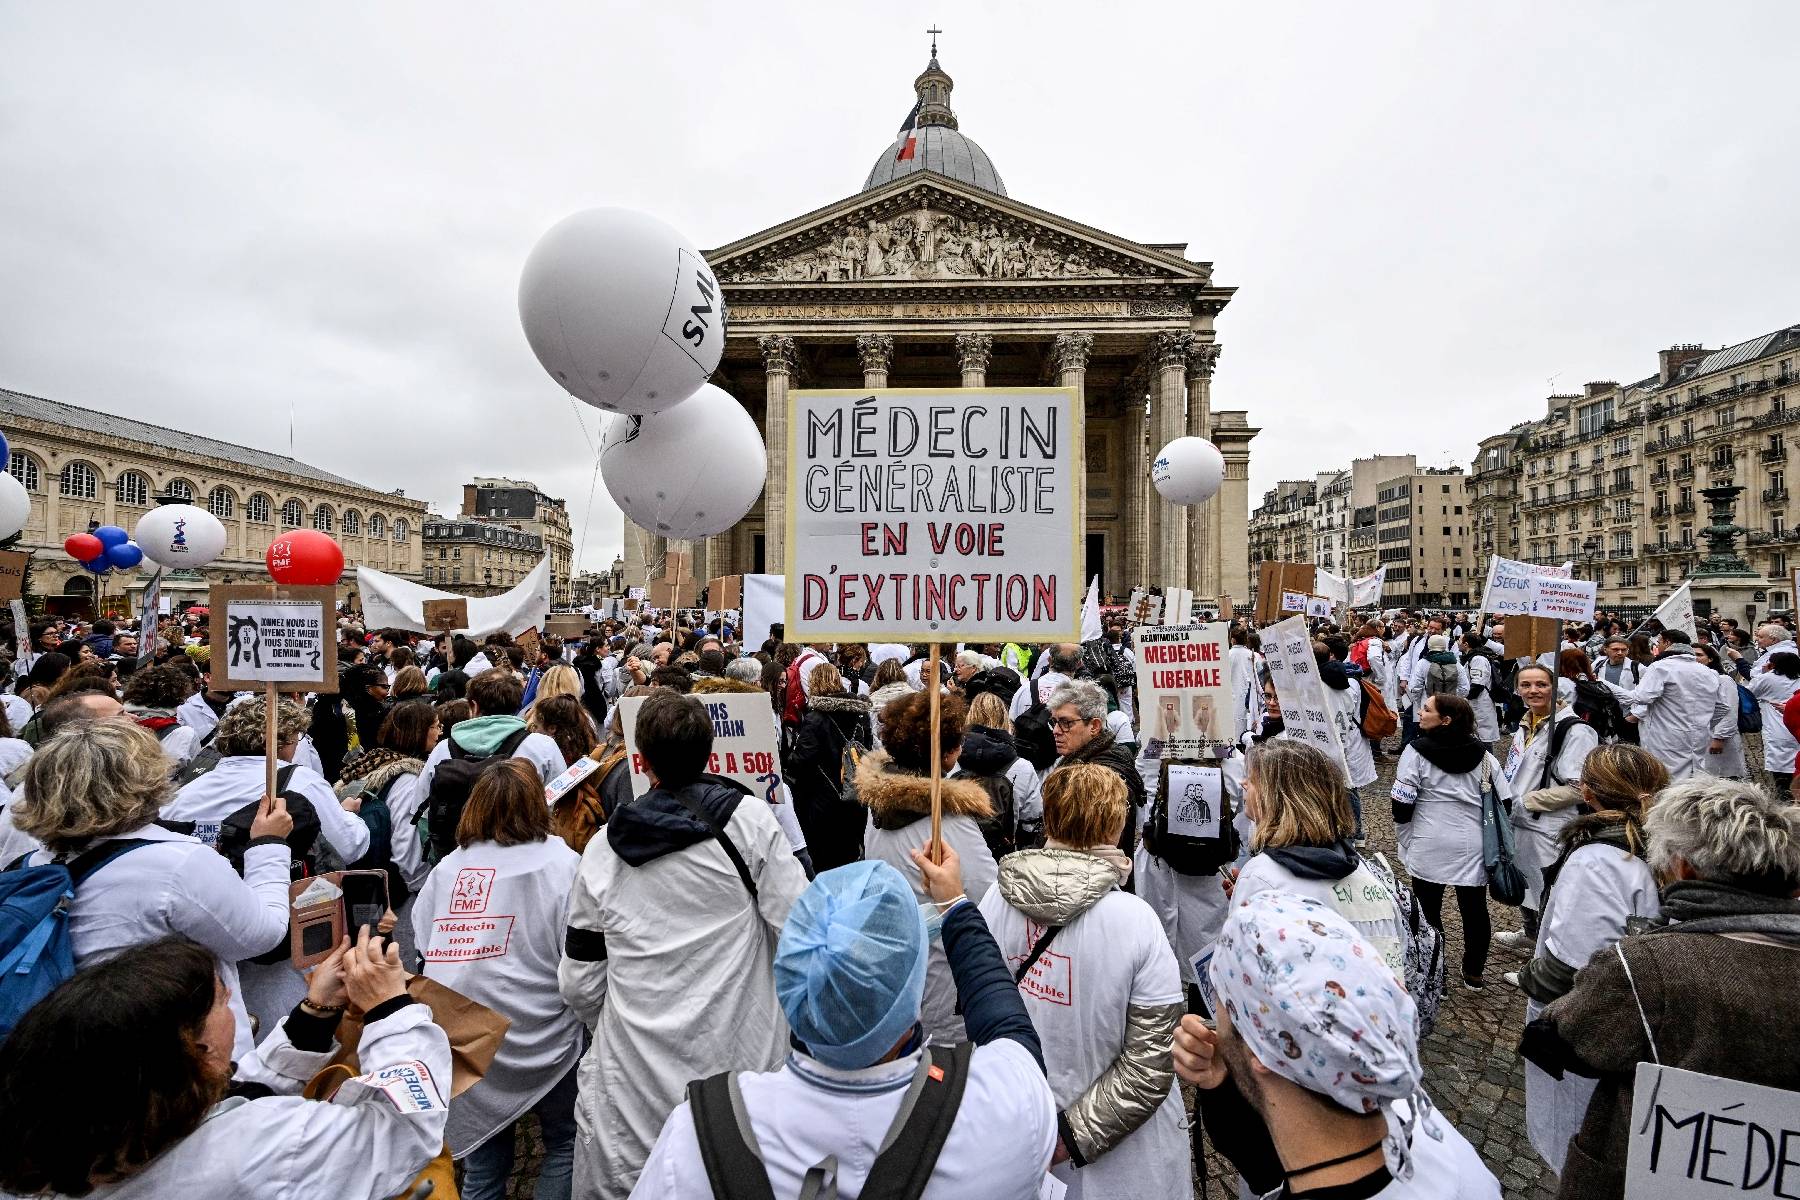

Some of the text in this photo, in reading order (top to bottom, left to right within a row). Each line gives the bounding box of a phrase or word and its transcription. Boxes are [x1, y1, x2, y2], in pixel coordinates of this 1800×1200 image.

[730, 302, 1123, 318] AUX GRANDS HOMMES LA PATRIE RECONNAISSANTE
[807, 396, 1057, 459] MÉDECIN
[806, 460, 1055, 514] GÉNÉRALISTE
[861, 522, 1005, 556] EN VOIE
[273, 558, 291, 567] FMF
[1493, 575, 1530, 590] SEGUR
[802, 565, 1057, 622] D'EXTINCTION
[1540, 589, 1590, 600] RESPONSABLE
[1546, 605, 1584, 615] PATIENTS
[286, 618, 306, 628] NOUS
[307, 619, 319, 628] LES
[287, 629, 296, 638] DE
[297, 629, 319, 639] MIEUX
[1180, 632, 1190, 641] LA
[284, 639, 313, 649] SOIGNER
[272, 648, 301, 658] DEMAIN
[1144, 642, 1221, 664] MEDECINE
[1152, 668, 1221, 689] LIBERALE
[705, 702, 729, 720] NS
[725, 752, 739, 774] A
[193, 824, 220, 834] CINE
[454, 899, 482, 911] FMF
[437, 922, 496, 933] Médecin
[448, 937, 475, 945] non
[426, 944, 502, 957] ubstituable
[1649, 1102, 1800, 1200] MÉDE
